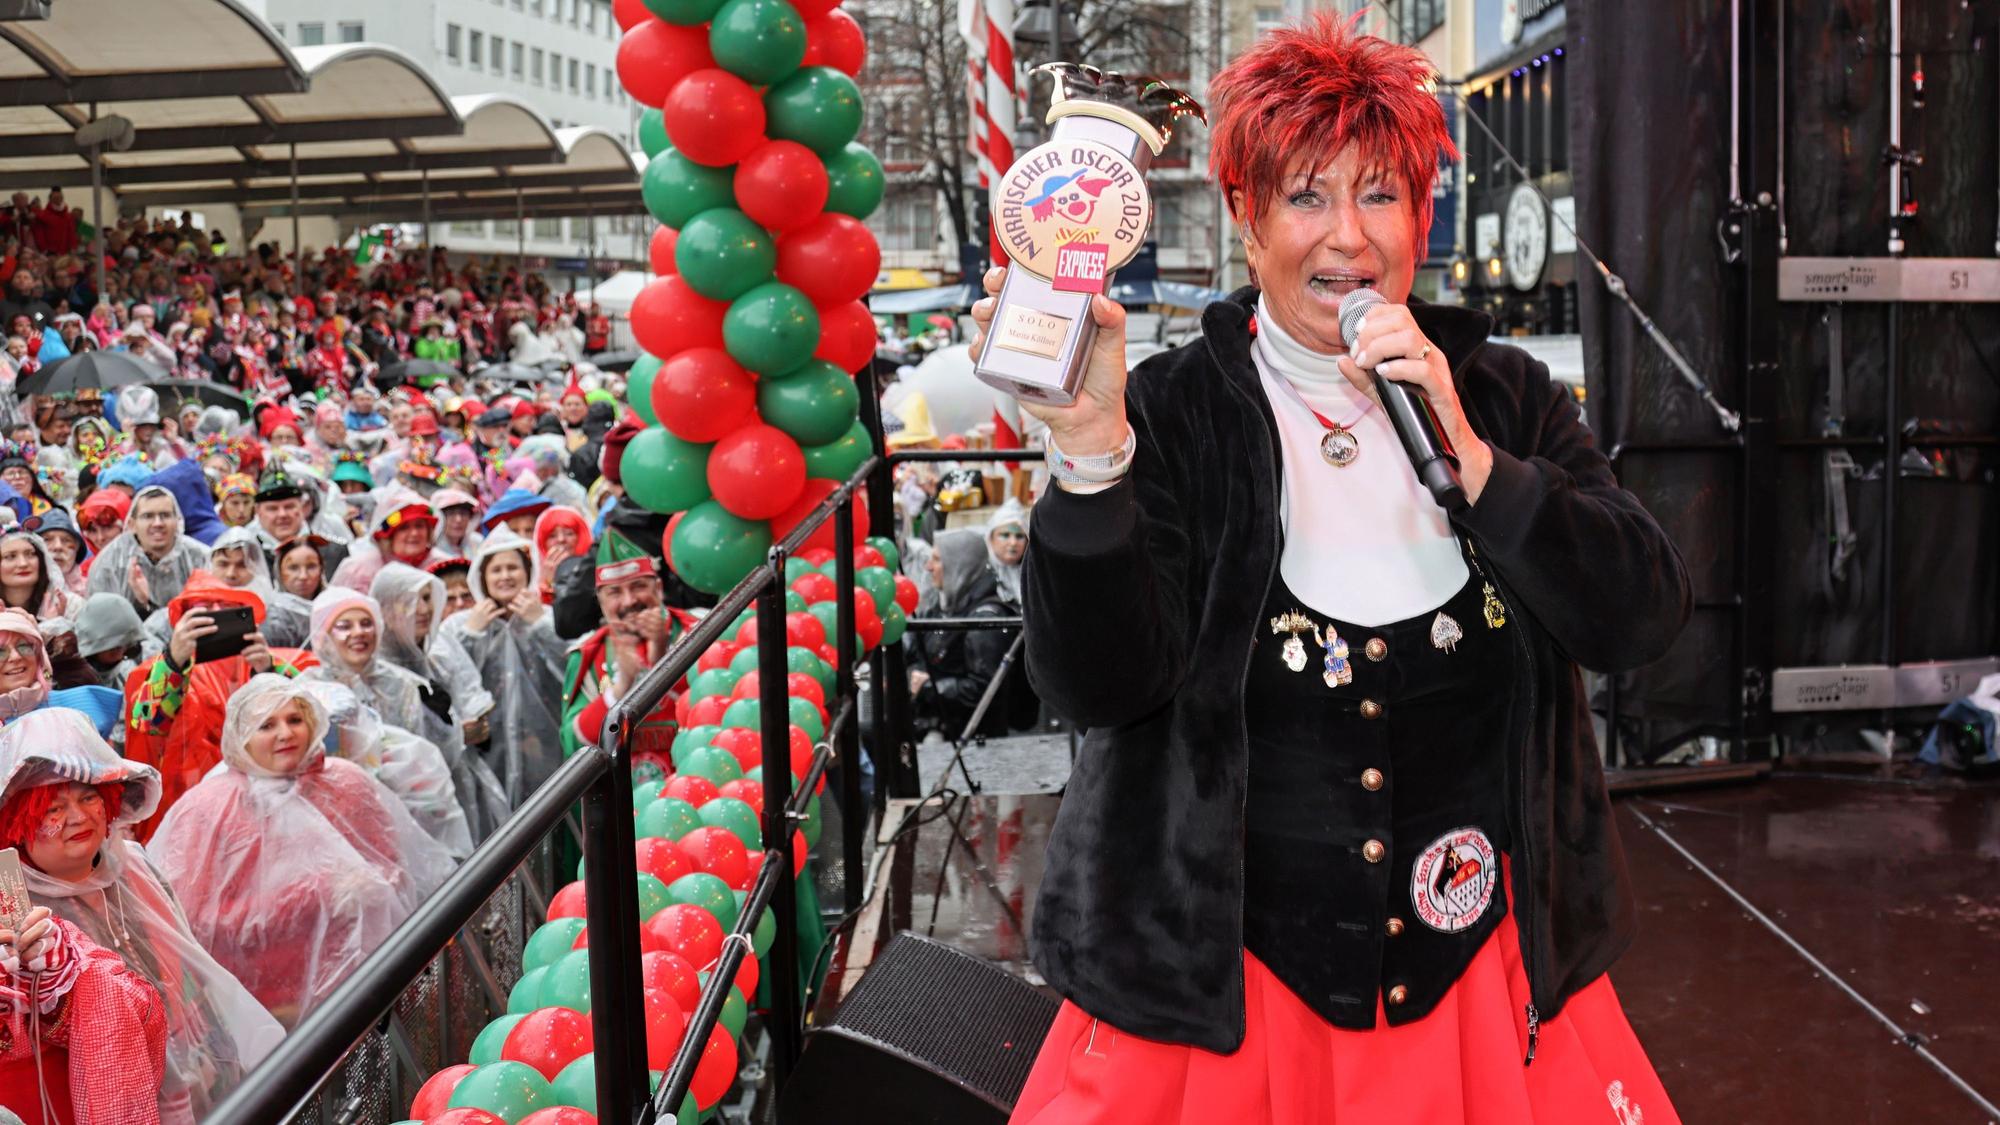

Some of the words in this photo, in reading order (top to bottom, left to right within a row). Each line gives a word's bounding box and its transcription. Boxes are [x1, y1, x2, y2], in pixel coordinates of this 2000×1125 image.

[1003, 151, 1062, 260] NÄRRISCHER
[1071, 148, 1133, 188] OSCAR
[1114, 191, 1142, 243] 2026
[1057, 249, 1106, 280] EXPRESS
[1950, 271, 1969, 289] 51
[1017, 313, 1056, 330] SOLO
[1942, 675, 1961, 693] 51
